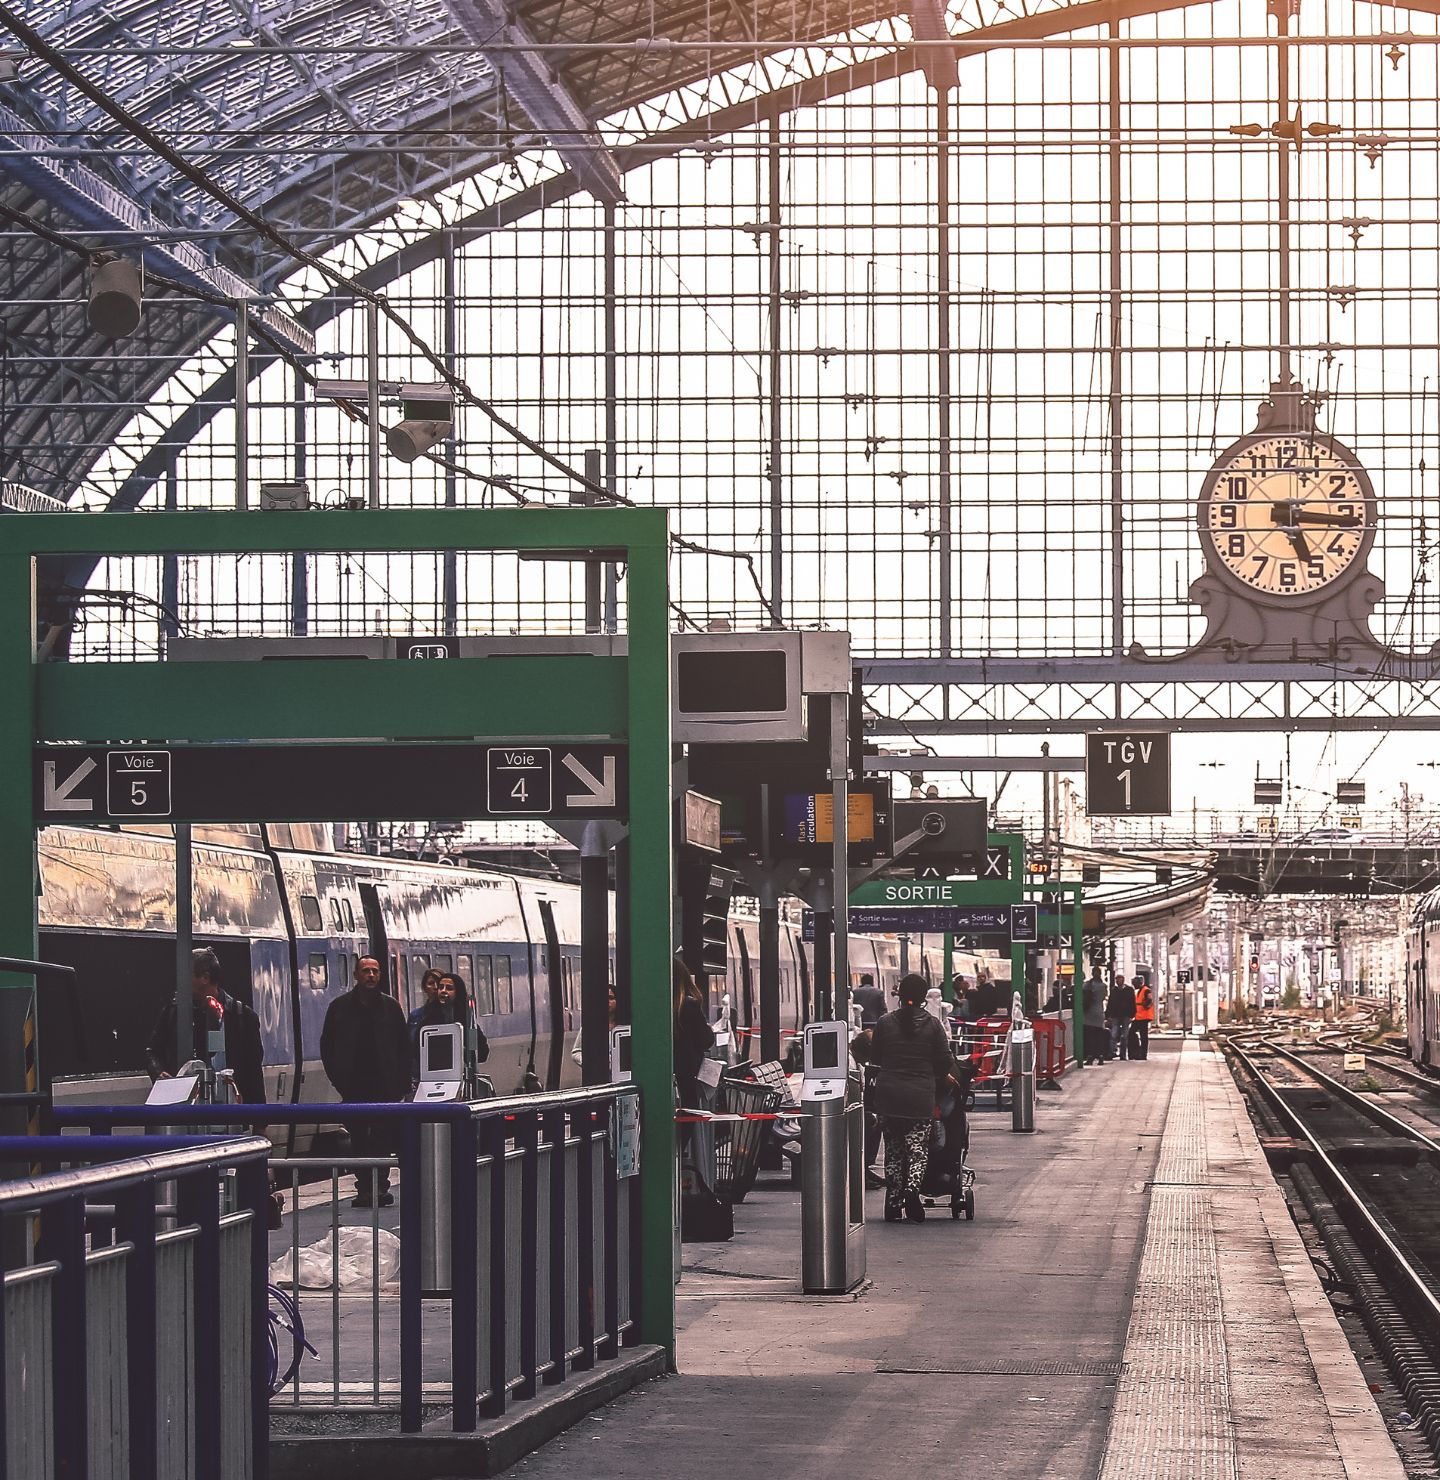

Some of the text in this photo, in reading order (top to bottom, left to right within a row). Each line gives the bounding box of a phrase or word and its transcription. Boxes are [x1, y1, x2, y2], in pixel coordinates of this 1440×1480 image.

[1251, 454, 1267, 478] 11
[1276, 446, 1298, 468] 12
[1313, 455, 1320, 478] 1
[1227, 477, 1247, 500] 10
[1329, 475, 1346, 499] 2
[1220, 504, 1237, 528] 9
[1228, 534, 1246, 558] 8
[1327, 533, 1345, 557] 4
[1252, 556, 1269, 580] 7
[1279, 563, 1296, 586] 6
[1308, 555, 1324, 579] 5
[124, 755, 155, 768] Voie
[504, 752, 535, 765] Voie
[1103, 741, 1153, 764] TGV
[131, 781, 147, 806] 5
[510, 777, 529, 802] 4
[1116, 769, 1131, 805] 1
[806, 795, 815, 843] circulation
[798, 821, 806, 842] flash
[984, 854, 1002, 875] X
[885, 885, 953, 900] SORTIE
[1050, 891, 1058, 903] Y
[858, 914, 881, 922] Sortie
[971, 913, 994, 922] Sortie
[1094, 948, 1102, 959] Z
